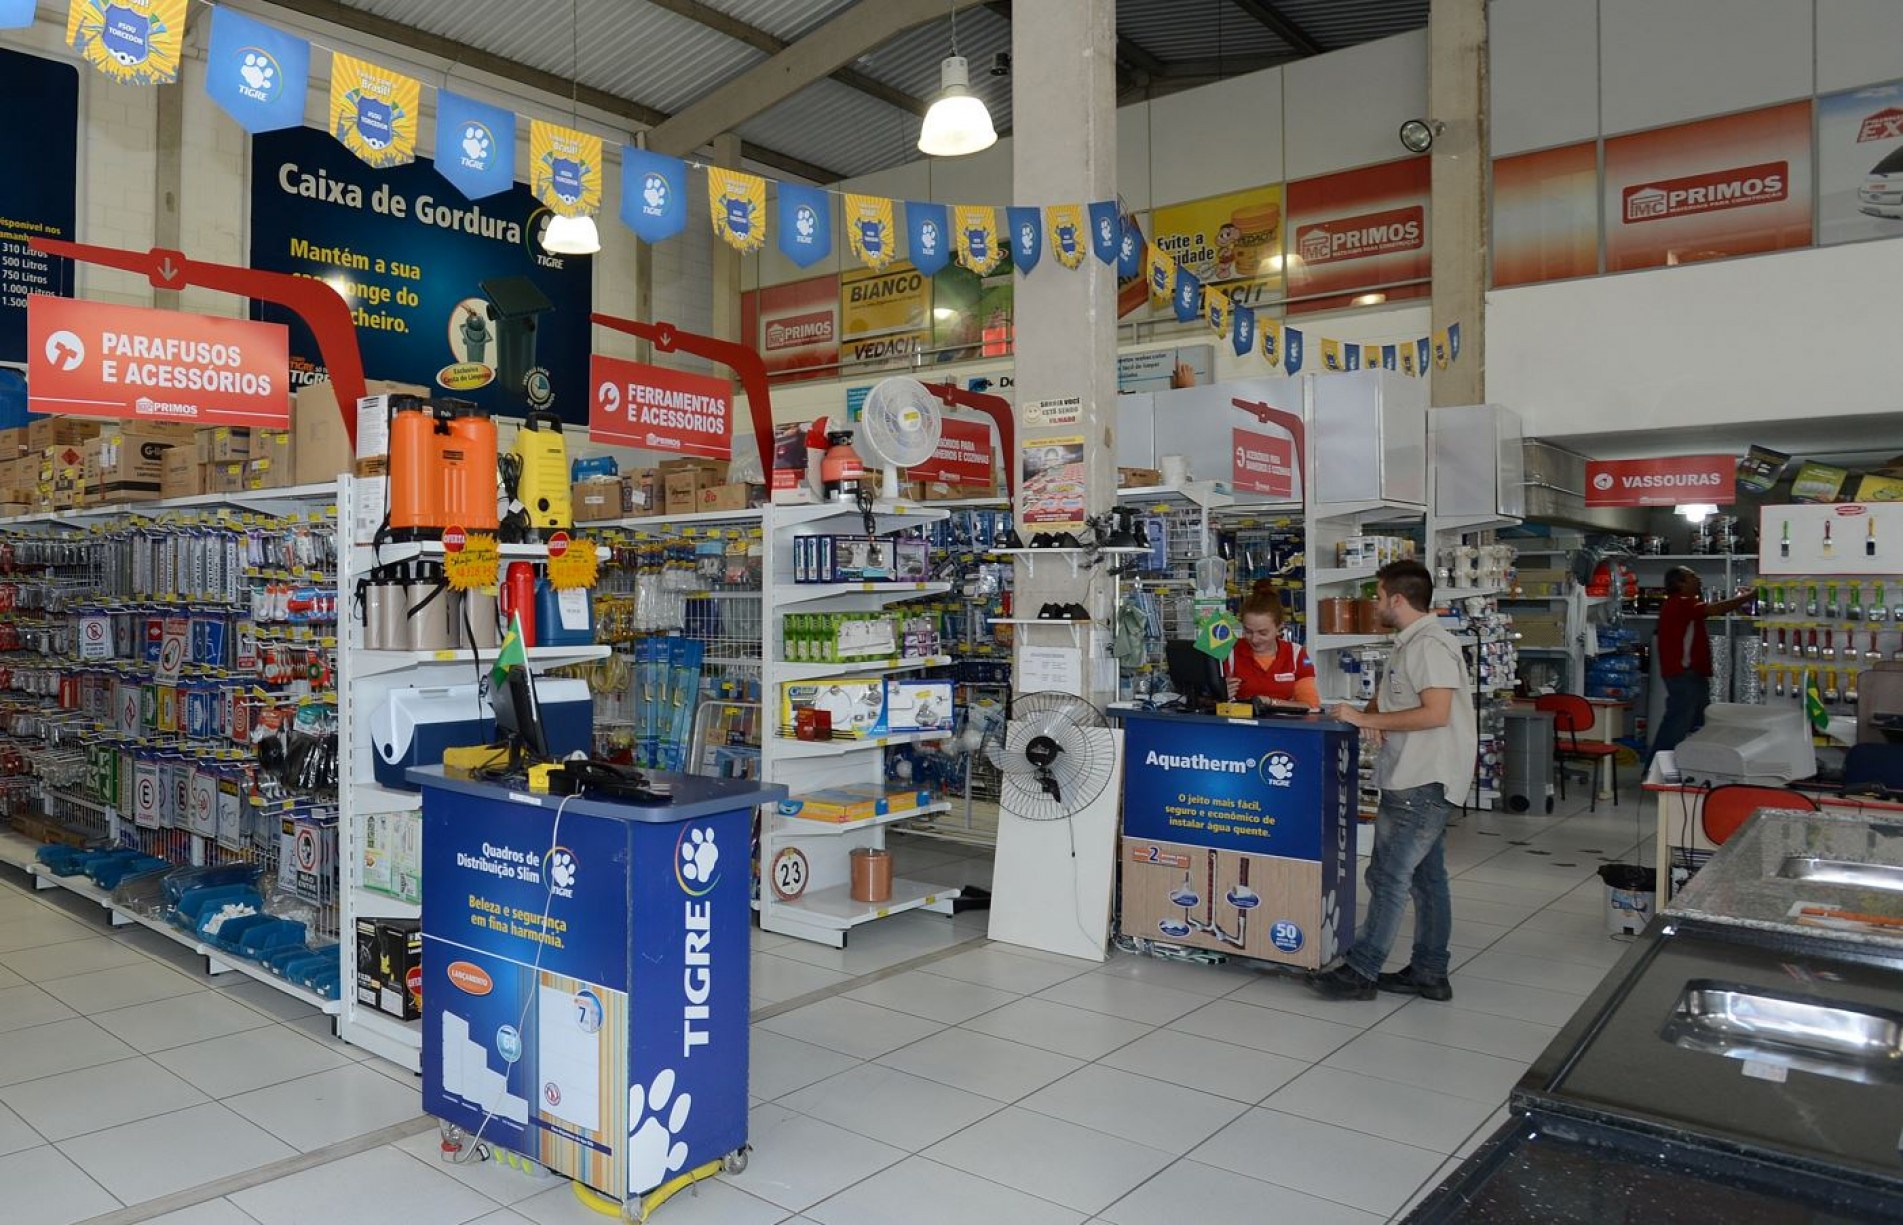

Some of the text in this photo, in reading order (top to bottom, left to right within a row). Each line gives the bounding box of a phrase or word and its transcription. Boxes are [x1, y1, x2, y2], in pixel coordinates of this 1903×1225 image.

[109, 26, 144, 46] TORCEDOR
[238, 84, 269, 102] TIGRE
[460, 156, 484, 170] TIGRE
[1669, 175, 1782, 207] PRIMOS
[278, 163, 521, 244] Caixa de Gordura
[643, 205, 662, 216] TIGRE
[44, 226, 61, 235] nos
[1333, 221, 1419, 250] PRIMOS
[2, 243, 19, 255] 310
[1157, 233, 1204, 250] Evite a
[2, 257, 48, 271] 500 Litros
[290, 238, 421, 281] Mantém a sua
[536, 254, 564, 270] TIGRE
[2, 270, 48, 284] 750 Litros
[2, 283, 27, 295] 1.000
[396, 286, 419, 307] do
[850, 274, 922, 302] BIANCO
[2, 297, 27, 307] 1.500
[785, 320, 831, 340] PRIMOS
[102, 332, 241, 367] PARAFUSOS
[855, 335, 922, 361] VEDACIT
[102, 360, 271, 396] E ACESSÓRIOS
[153, 402, 197, 415] PRIMOS
[628, 383, 726, 416] FERRAMENTAS
[627, 404, 724, 435] E ACESSÓRIOS
[1622, 472, 1721, 488] VASSOURAS
[1268, 778, 1291, 787] TIGRE
[1178, 793, 1186, 802] O
[1188, 794, 1210, 806] jeito
[1212, 797, 1235, 808] mais
[1165, 805, 1197, 817] seguro
[1207, 808, 1260, 823] econômico
[1262, 814, 1276, 826] de
[1169, 817, 1271, 838] instalar água quente.
[1337, 783, 1349, 882] TIGRE
[482, 842, 539, 867] Quadros de
[1149, 848, 1159, 862] 2
[457, 852, 540, 884] Distribuição Slim
[552, 886, 573, 899] TIGRE
[469, 894, 566, 933] Beleza e segurança
[471, 914, 565, 949] em fina harmonia.
[1276, 923, 1297, 939] 50
[684, 900, 711, 1058] TIGRE
[579, 1005, 586, 1023] 7
